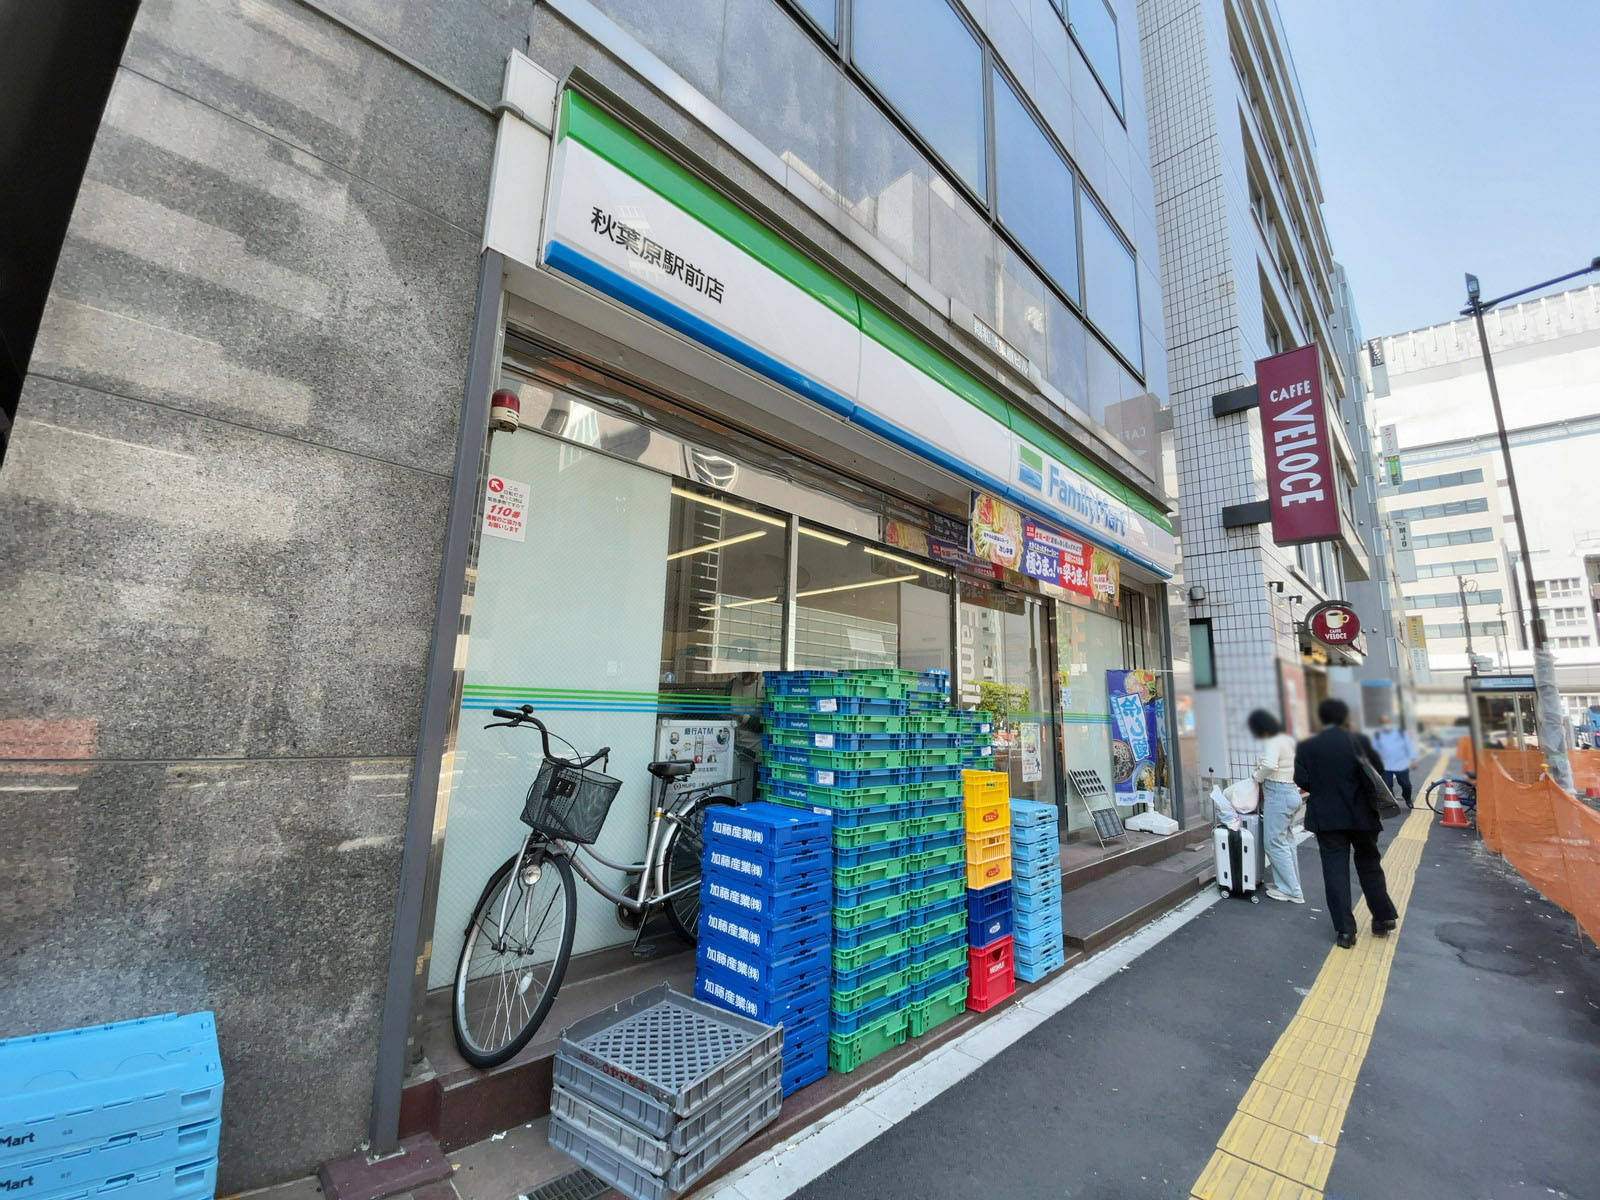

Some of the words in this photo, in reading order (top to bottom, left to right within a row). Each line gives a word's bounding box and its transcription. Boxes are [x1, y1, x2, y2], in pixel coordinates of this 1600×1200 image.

[590, 206, 725, 304] 秋葉原駅前店
[1272, 398, 1324, 507] VELOCE
[490, 505, 521, 518] 110番
[1048, 464, 1126, 537] FamilyMart
[488, 522, 520, 532] お願いします
[684, 727, 714, 736] 銀行ATM
